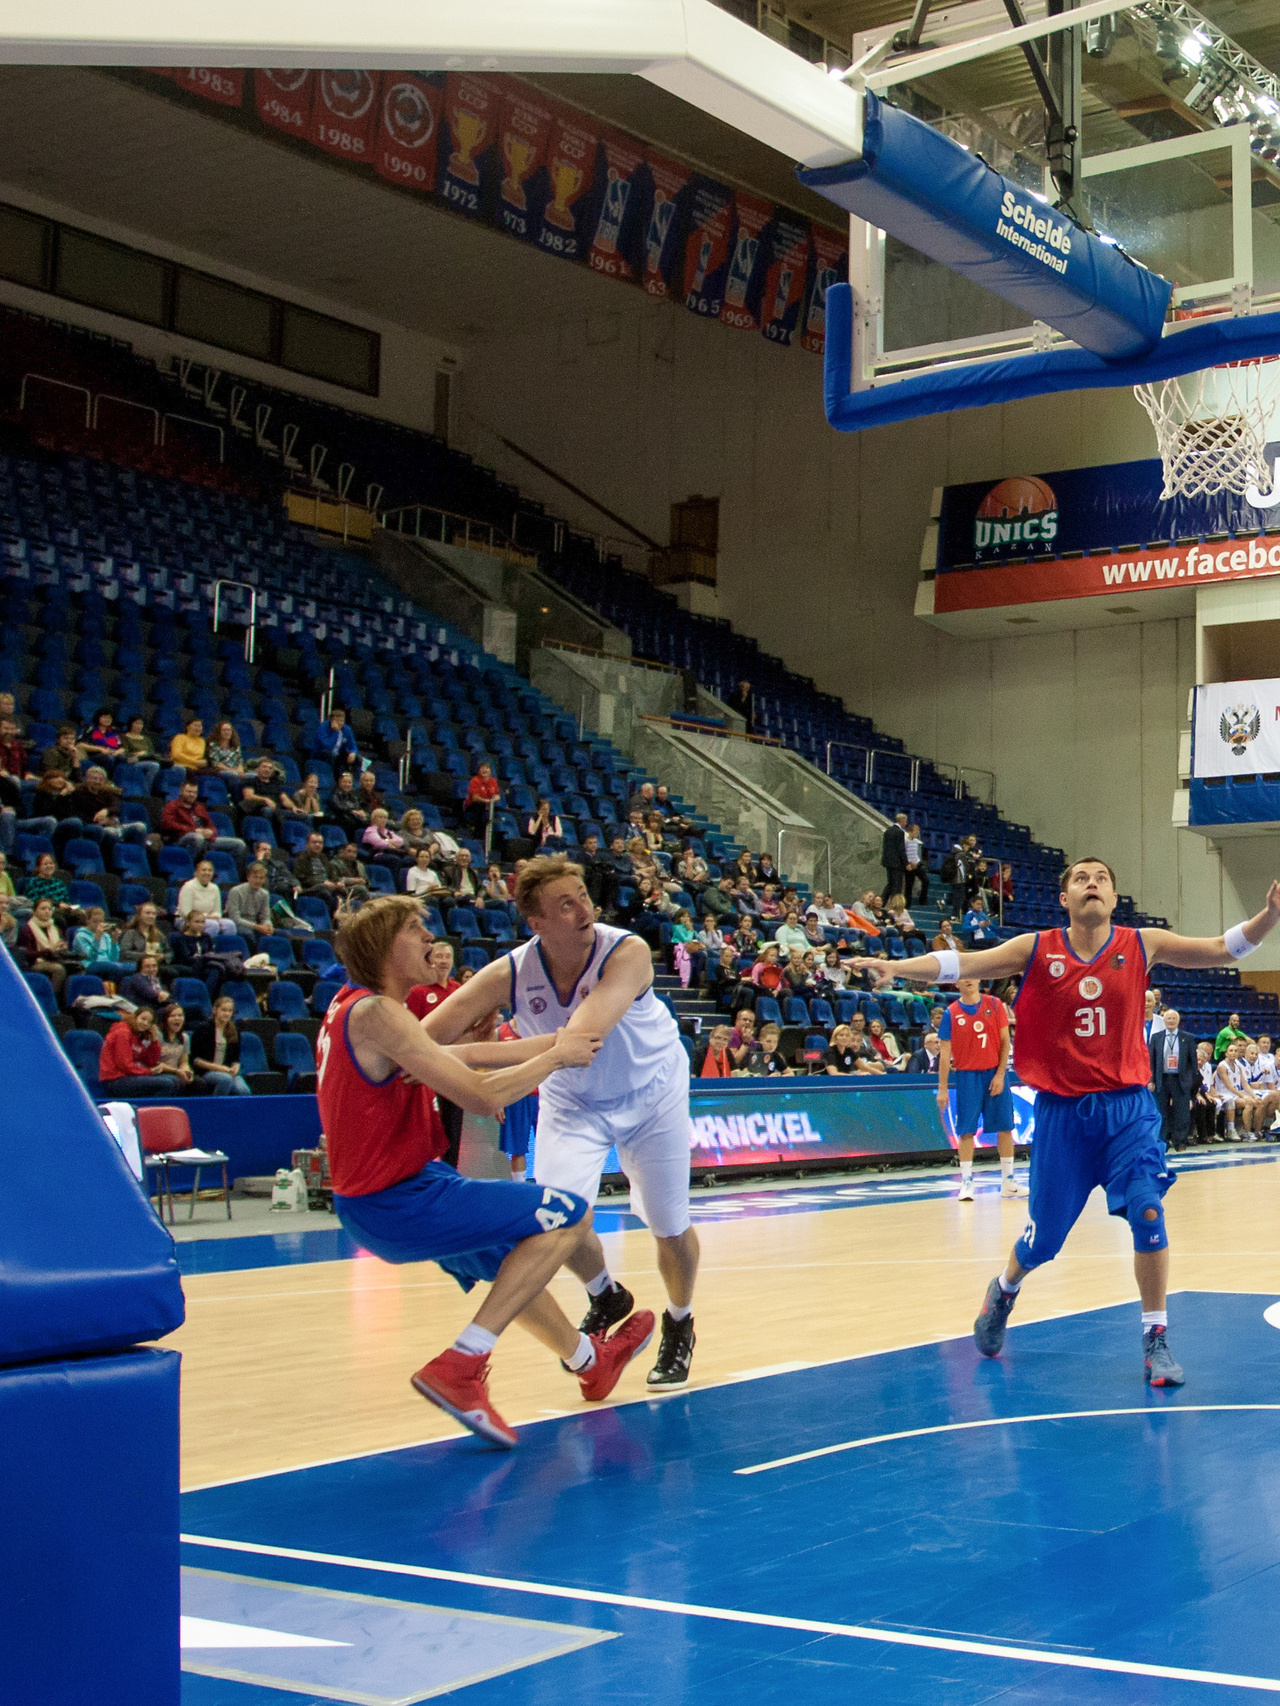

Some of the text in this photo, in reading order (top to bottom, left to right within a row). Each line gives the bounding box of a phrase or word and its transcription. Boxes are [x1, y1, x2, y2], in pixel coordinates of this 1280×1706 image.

[187, 67, 236, 96] 1983
[318, 124, 365, 154] 1988
[383, 152, 427, 181] 1990
[442, 180, 479, 210] 1972
[1000, 191, 1072, 255] Schelde
[538, 228, 577, 254] 1982
[996, 218, 1068, 275] International
[589, 252, 628, 276] 1961
[974, 511, 1057, 549] UNICS
[975, 543, 1052, 559] KAZAN
[1075, 1007, 1106, 1037] 31
[977, 1033, 987, 1048] 7
[689, 1111, 822, 1149] RNICKEL
[534, 1187, 576, 1233] 47
